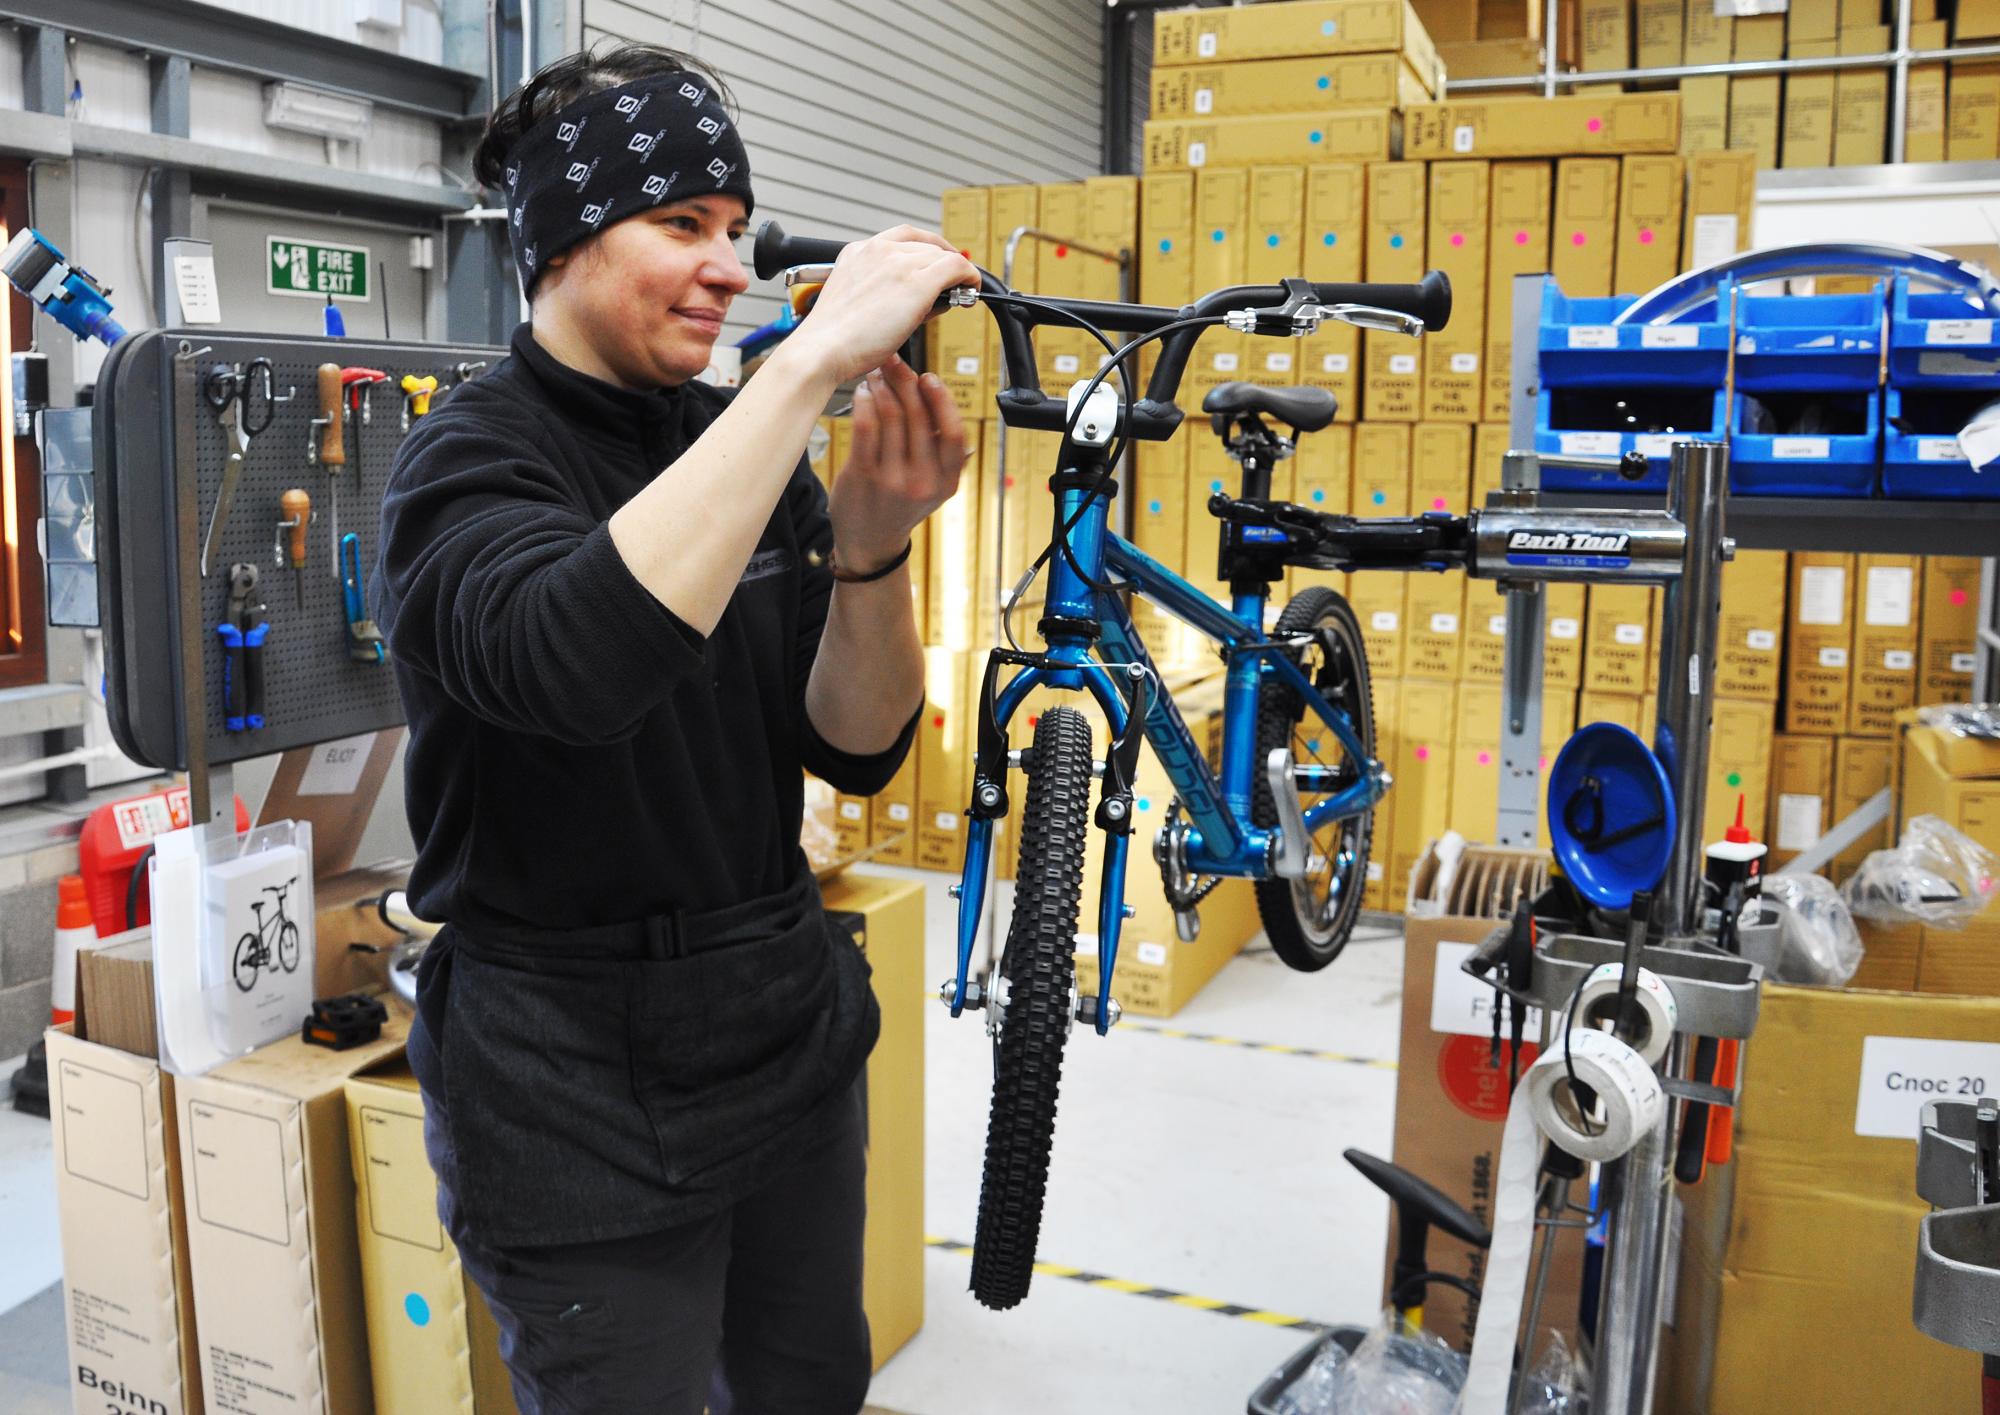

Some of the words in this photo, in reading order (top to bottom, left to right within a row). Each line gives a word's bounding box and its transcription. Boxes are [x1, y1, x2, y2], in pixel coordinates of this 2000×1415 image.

[317, 249, 353, 272] FIRE
[317, 271, 354, 293] EXIT
[1509, 532, 1570, 550] Park
[1571, 533, 1630, 552] Tool
[1885, 1071, 1949, 1094] Cnoc
[1957, 1075, 1986, 1095] 20
[77, 1365, 168, 1415] Beinn
